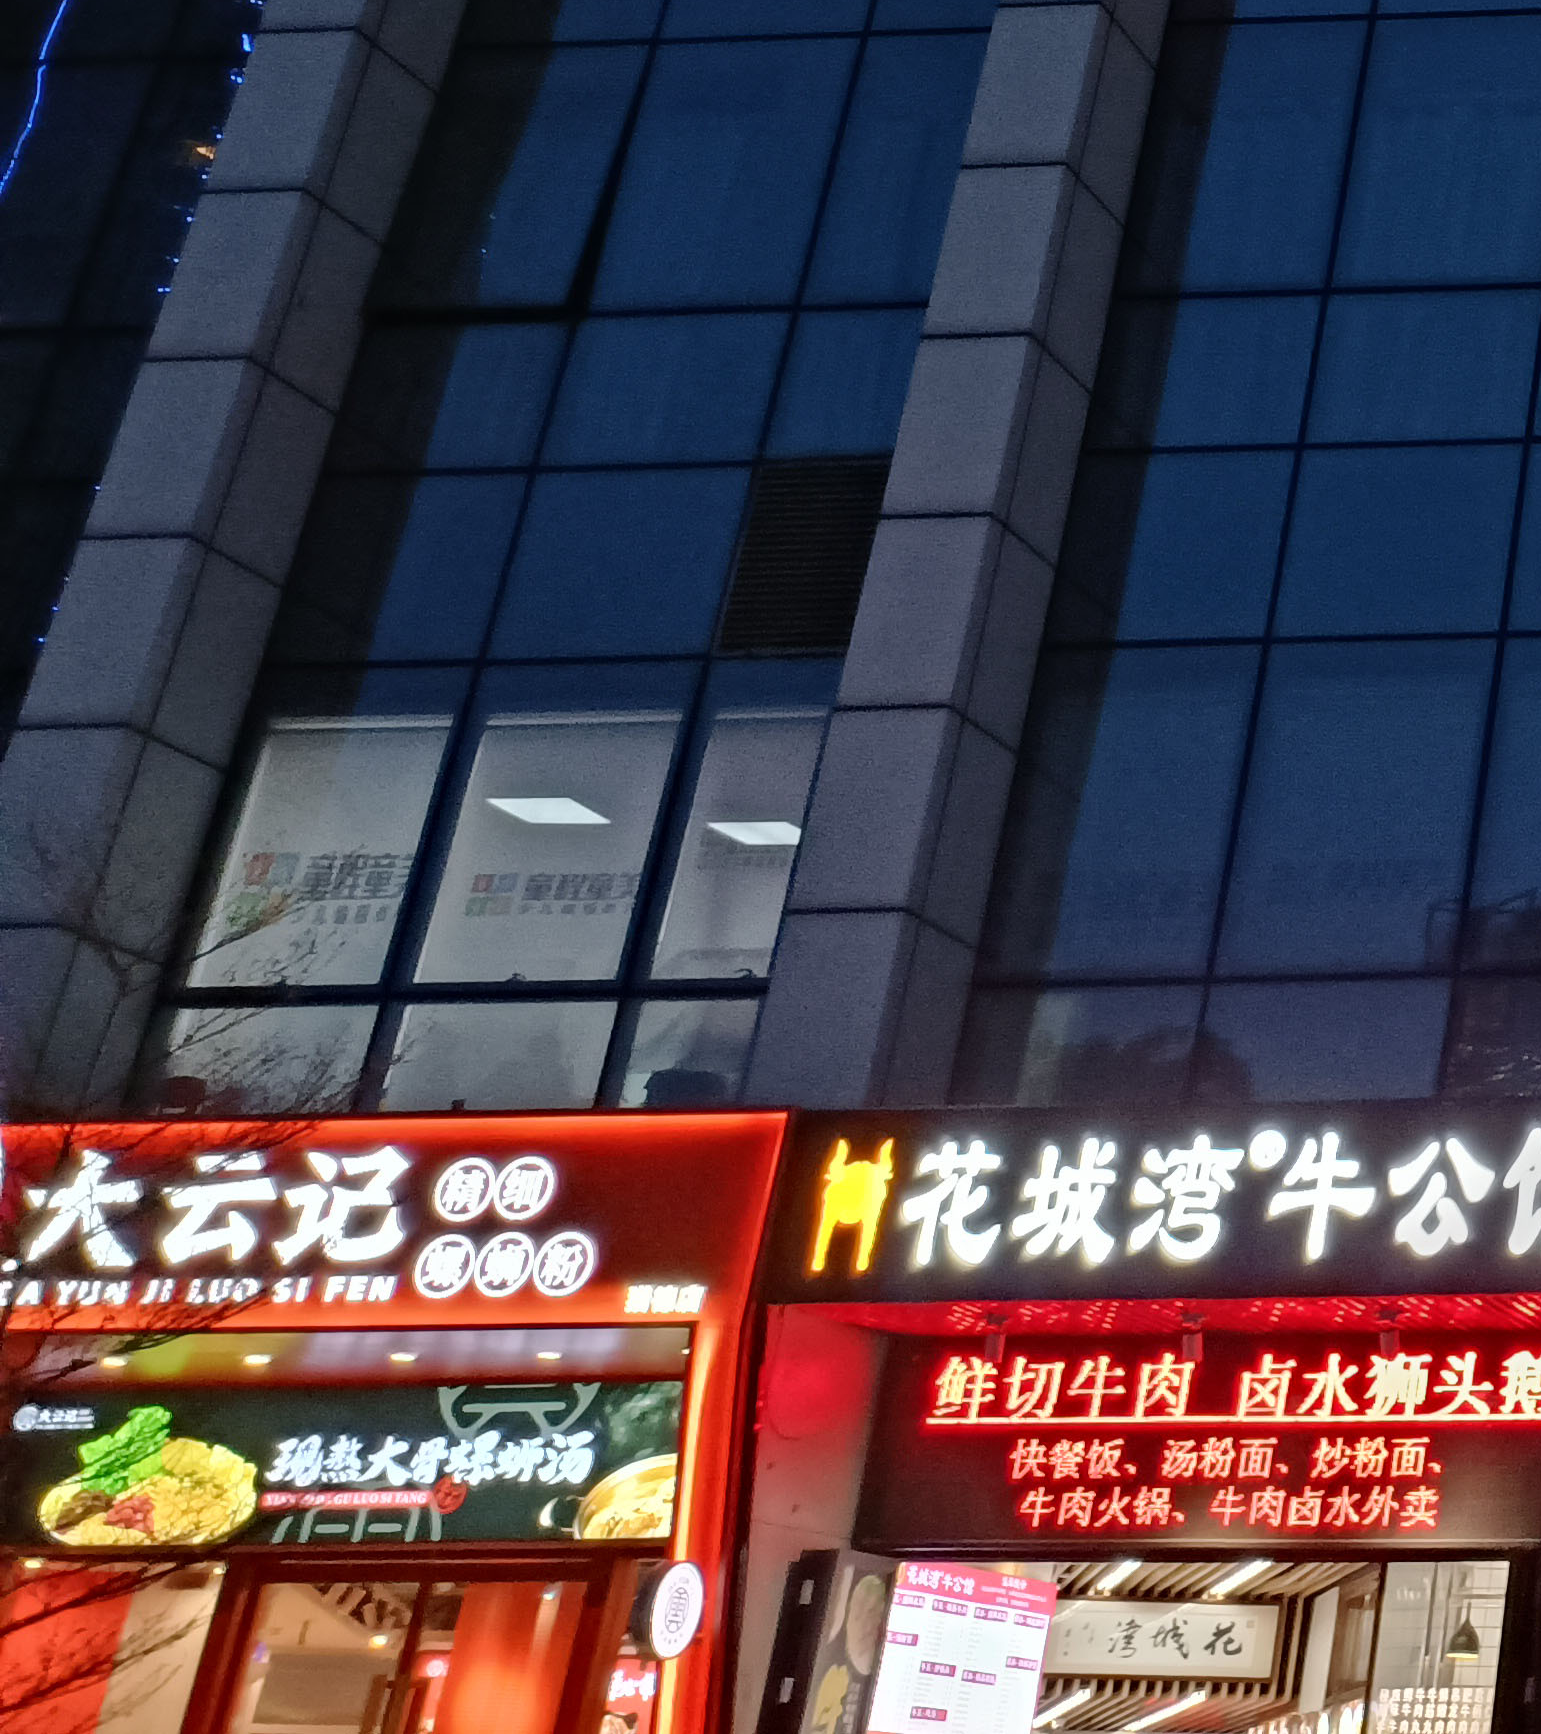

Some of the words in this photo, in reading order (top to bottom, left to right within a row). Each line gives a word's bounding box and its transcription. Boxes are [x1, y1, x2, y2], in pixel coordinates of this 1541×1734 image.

[0, 1144, 411, 1270] 大云记
[271, 1276, 312, 1304] SI
[323, 1274, 399, 1304] FEN
[933, 1352, 1197, 1418] 鲜切牛肉
